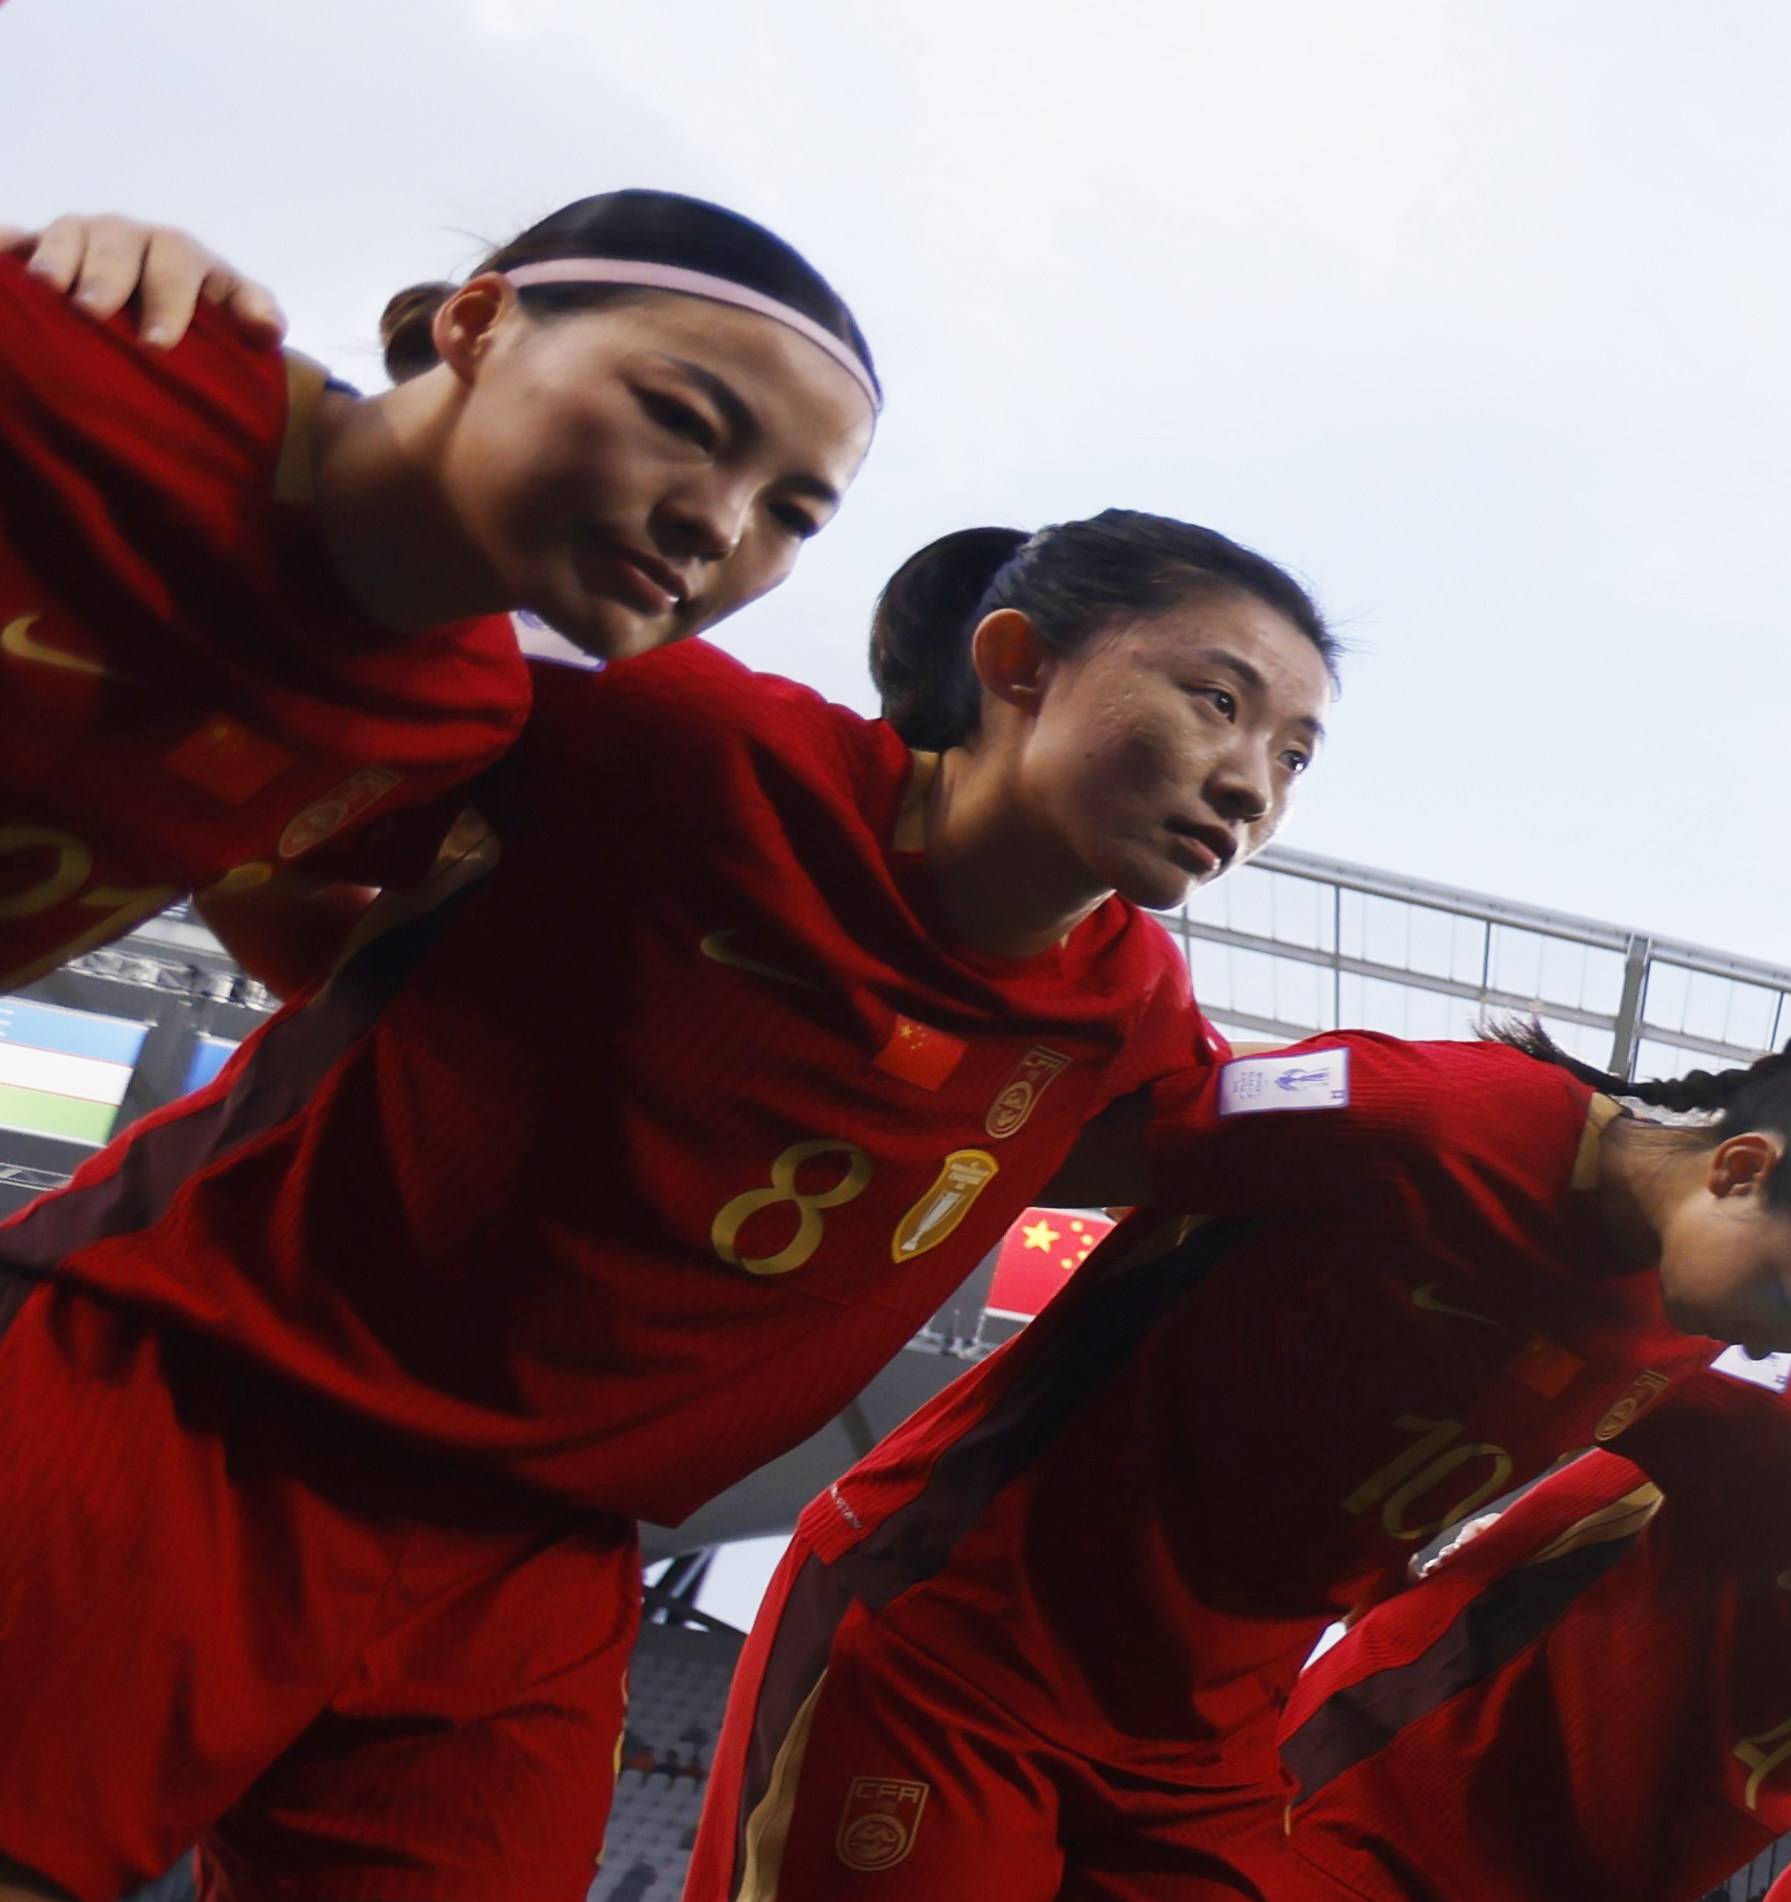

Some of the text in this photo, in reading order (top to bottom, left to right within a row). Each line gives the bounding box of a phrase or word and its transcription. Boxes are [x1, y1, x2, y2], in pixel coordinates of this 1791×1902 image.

[711, 1139, 873, 1276] 8
[1341, 1412, 1514, 1541] 10
[856, 1782, 921, 1804] CFA
